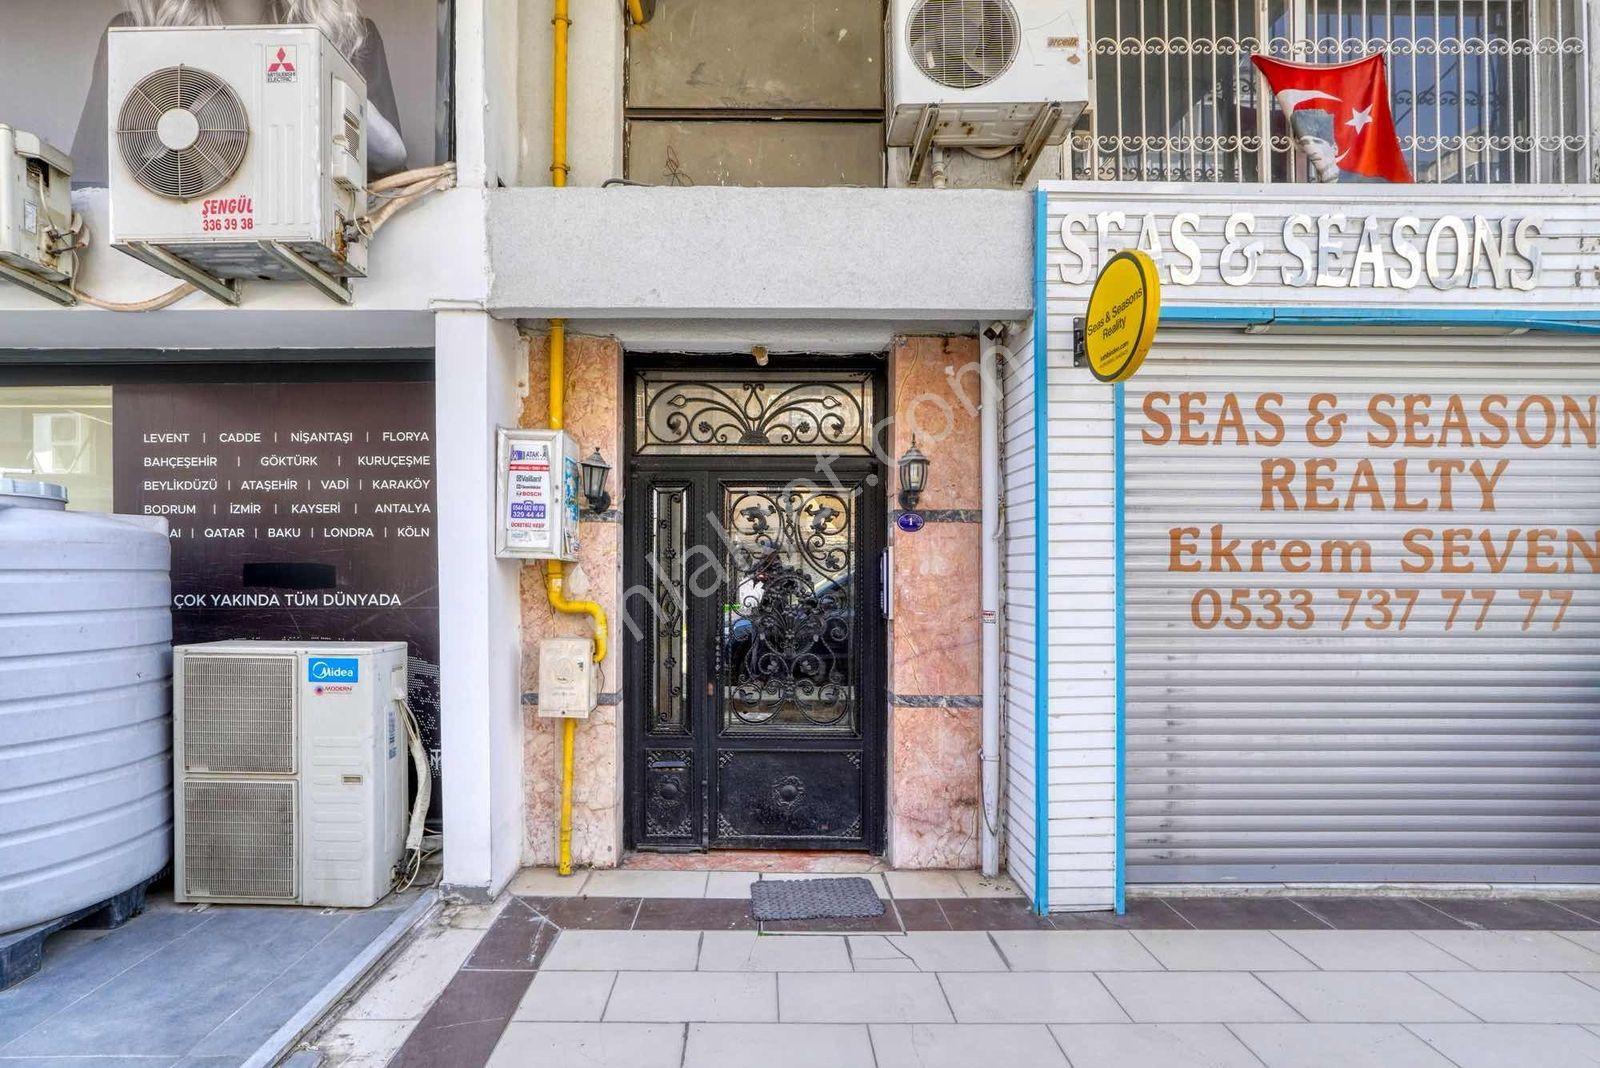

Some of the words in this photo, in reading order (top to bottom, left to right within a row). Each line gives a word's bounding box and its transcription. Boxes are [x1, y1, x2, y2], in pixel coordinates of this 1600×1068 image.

[202, 195, 254, 218] ŞENGÜL
[203, 218, 221, 231] 336
[224, 218, 237, 231] 39
[240, 218, 254, 230] 38
[1219, 212, 1263, 286] &
[1282, 213, 1543, 291] SEASONS
[1088, 318, 1104, 336] Seas
[1112, 288, 1143, 316] Seasons
[1141, 391, 1286, 446] SEAS
[1305, 393, 1348, 447] &
[1366, 393, 1597, 449] SEASON
[144, 433, 190, 443] LEVENT
[219, 432, 261, 443] CADDE
[290, 430, 353, 444] NİŞANTAŞI
[382, 432, 430, 442] FLORYA
[144, 455, 218, 468] BAHÇEŞEHİR
[260, 454, 318, 466] GÖKTÜRK
[357, 455, 431, 468] KURUÇEŞME
[144, 479, 218, 491] BEYLİKDÜZÜ
[241, 478, 298, 492] ATAŞEHİR
[321, 478, 349, 490] VADİ
[372, 478, 431, 490] KARAKÖY
[1259, 458, 1510, 512] REALTY
[144, 504, 196, 515] BODRUM
[230, 502, 261, 514] İZMİR
[291, 503, 341, 514] KAYSERİ
[375, 503, 431, 514] ANTALYA
[204, 528, 245, 538] QATAR
[268, 528, 301, 538] BAKU
[324, 528, 374, 538] LONDRA
[398, 526, 430, 537] KÖLN
[1168, 524, 1372, 573] Ekrem
[1400, 527, 1600, 574] SEVEN
[174, 594, 207, 609] ÇOK
[211, 594, 280, 606] YAKINDA
[284, 592, 318, 606] TÜM
[323, 592, 402, 606] DÜNYADA
[1191, 588, 1315, 630] 0533
[1337, 589, 1420, 632] 737
[1441, 589, 1496, 632] 77
[1518, 589, 1574, 632] 77
